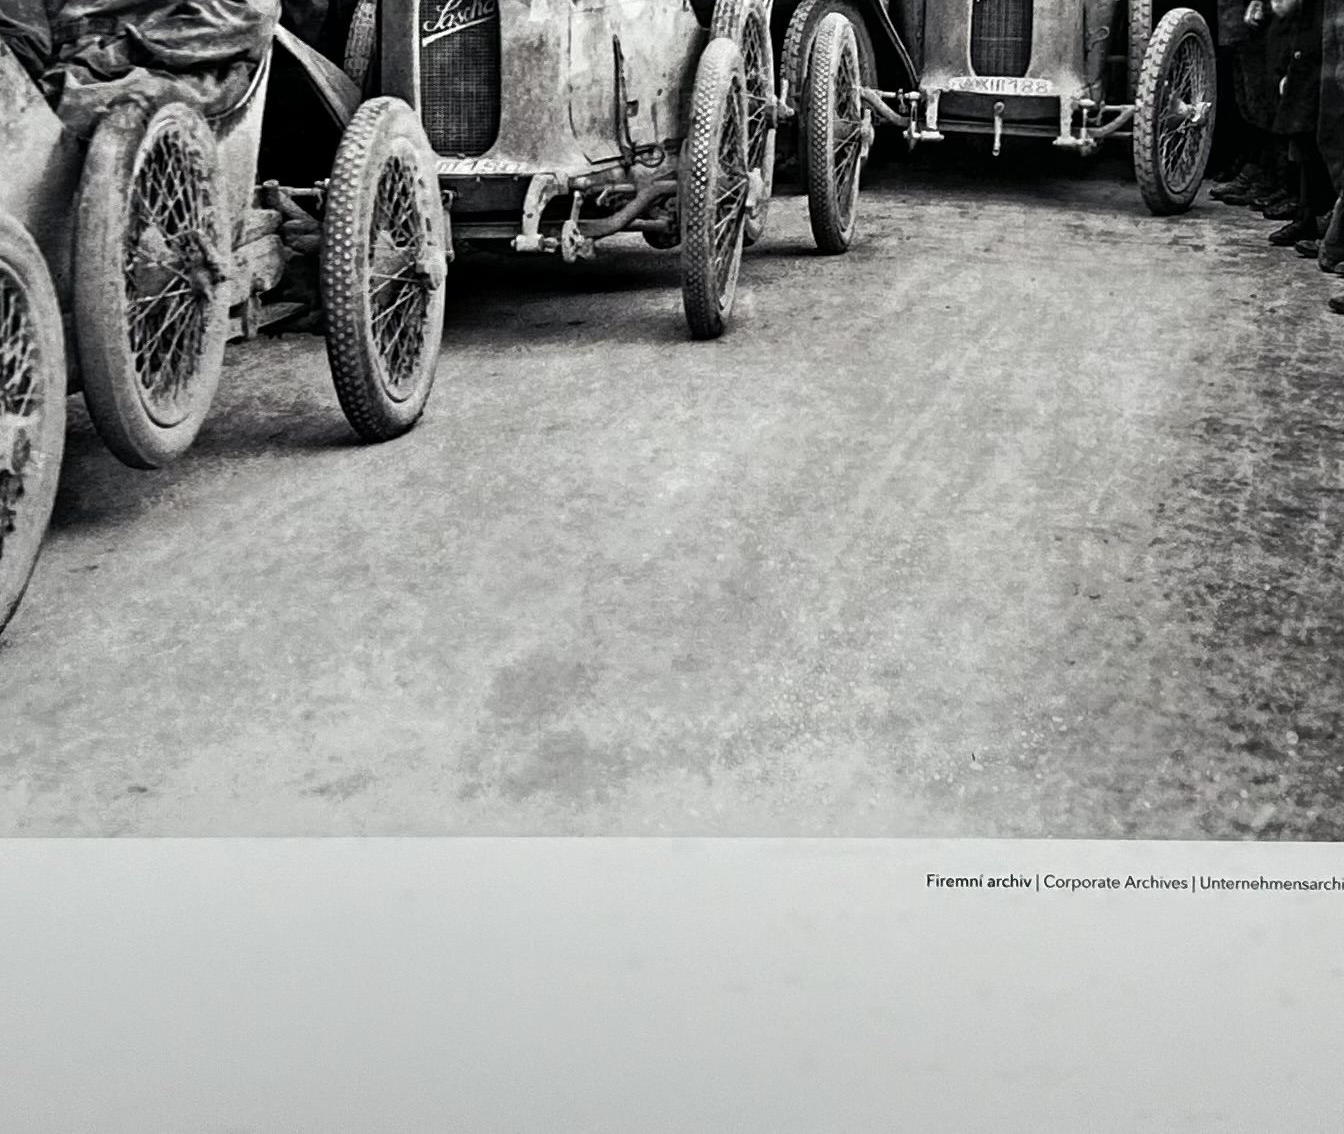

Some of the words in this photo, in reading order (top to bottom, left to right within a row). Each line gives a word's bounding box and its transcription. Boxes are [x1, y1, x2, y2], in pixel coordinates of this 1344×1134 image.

[927, 874, 983, 888] Firemní
[987, 874, 1032, 889] archiv
[1044, 874, 1120, 893] Corporate
[1124, 875, 1188, 890] Archives
